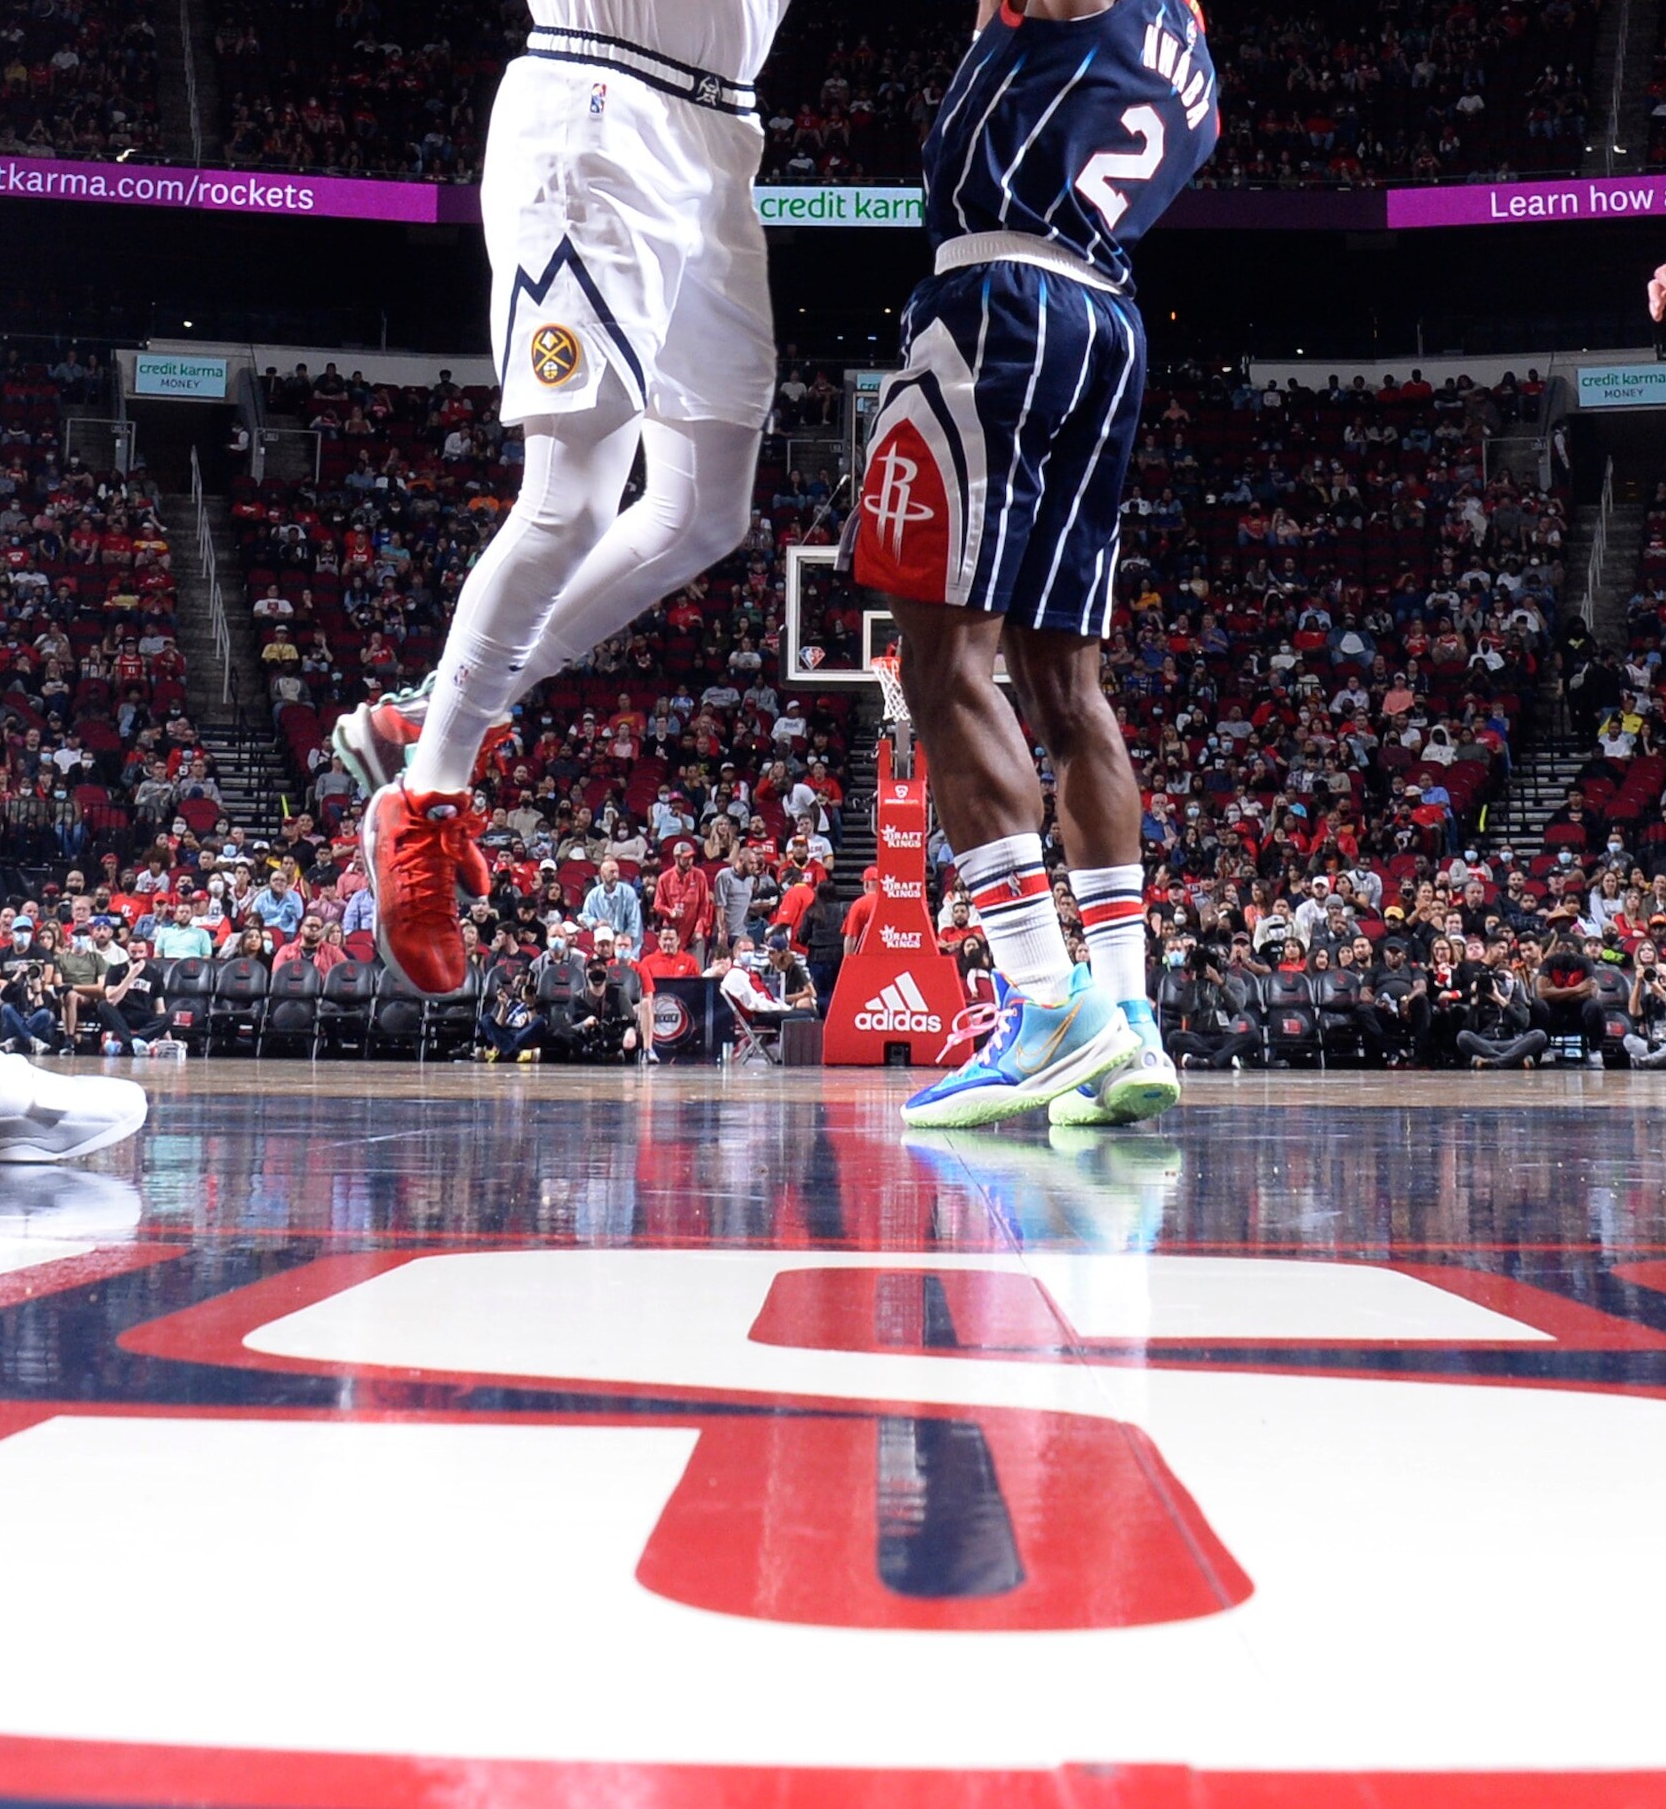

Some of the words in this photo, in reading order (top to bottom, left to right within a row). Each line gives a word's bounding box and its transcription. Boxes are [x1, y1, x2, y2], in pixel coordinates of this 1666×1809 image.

[1075, 104, 1165, 230] 2
[760, 191, 847, 218] credit
[1489, 189, 1578, 221] Learn
[1588, 184, 1655, 213] how
[139, 362, 177, 375] credit
[180, 363, 223, 377] karma
[160, 379, 200, 389] MONEY
[1582, 373, 1618, 386] credit
[1623, 373, 1665, 384] karma
[1605, 388, 1643, 398] MONEY
[883, 832, 922, 840] DRAFT
[887, 839, 921, 848] KINGS
[883, 882, 922, 891] DRAFT
[887, 889, 921, 898] KINGS
[882, 932, 922, 941] DRAFT
[887, 940, 921, 949] KINGS
[855, 1009, 942, 1032] adidas
